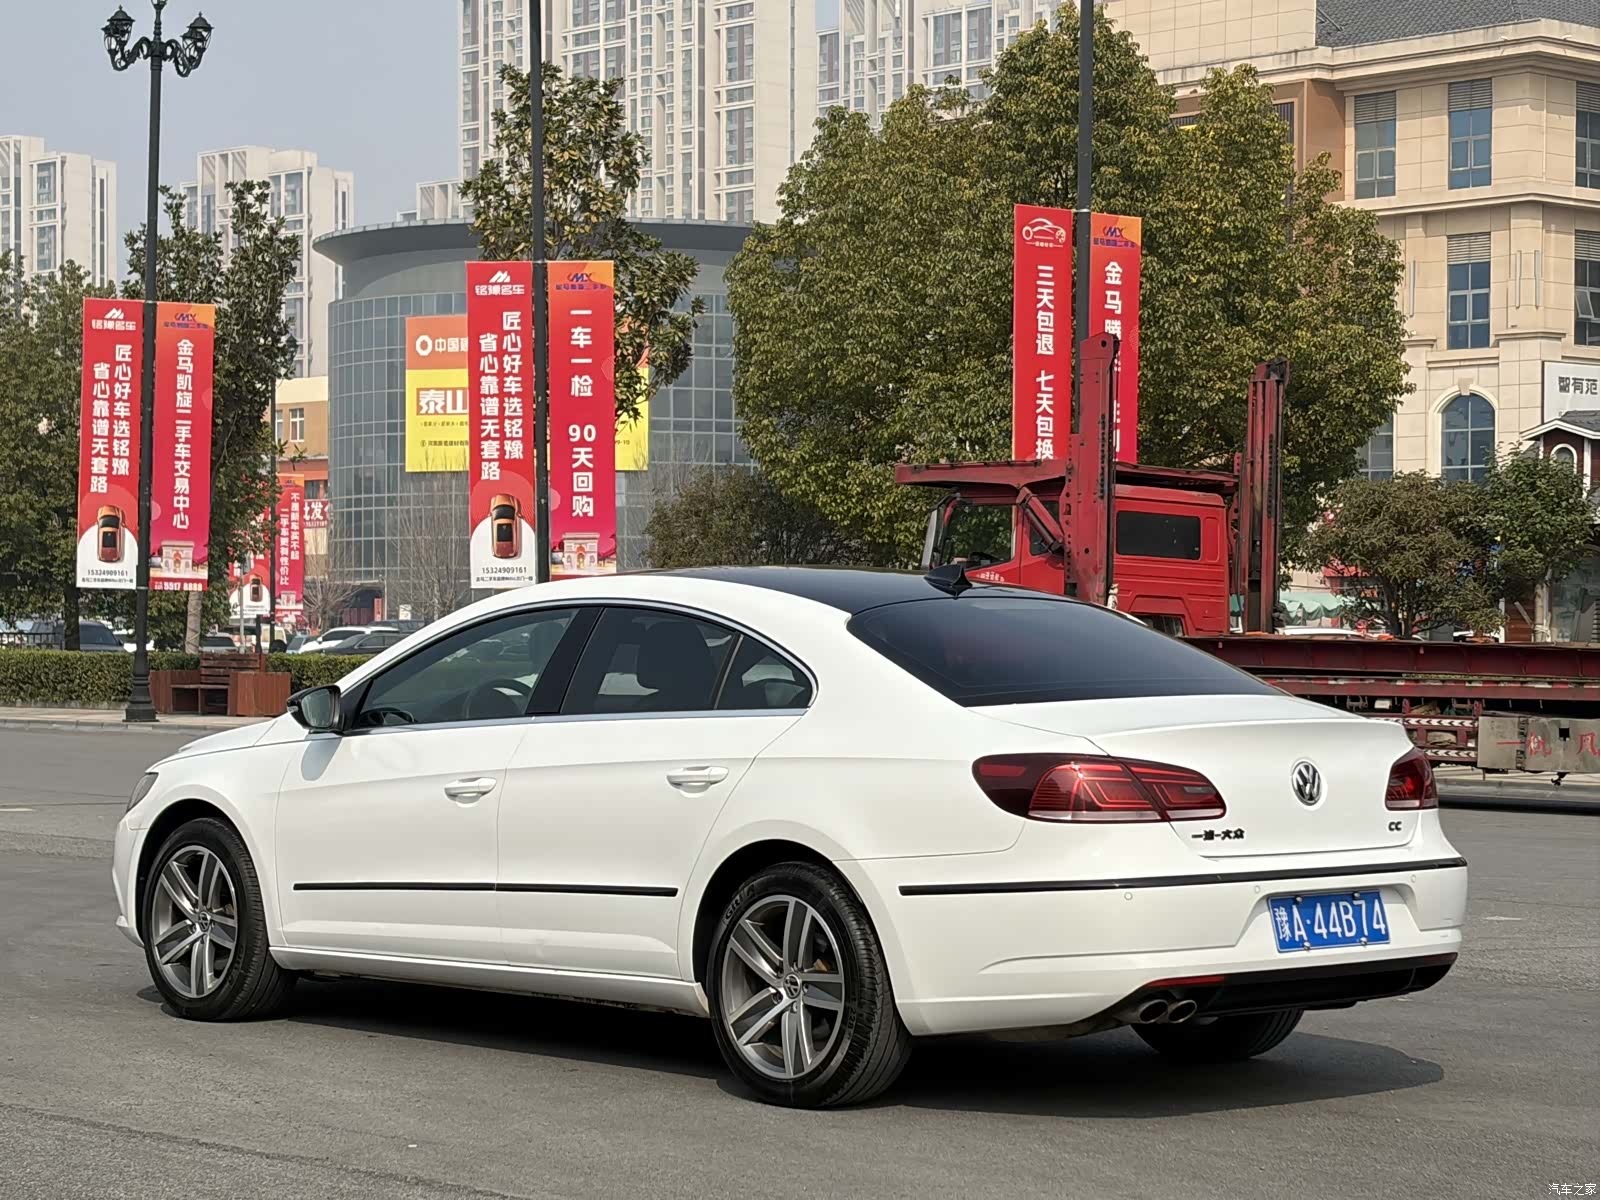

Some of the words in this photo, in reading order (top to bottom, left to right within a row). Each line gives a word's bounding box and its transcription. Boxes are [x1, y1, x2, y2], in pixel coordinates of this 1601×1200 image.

[570, 309, 593, 397] 一车一检
[1036, 266, 1054, 355] 三天包退
[90, 362, 111, 493] 省心靠谱无套路
[112, 344, 131, 476] 匠心好车选铭豫
[479, 334, 500, 480] 省心靠谱无套路
[503, 311, 523, 460] 匠心好车选铭豫
[1036, 370, 1054, 460] 七天包换
[172, 339, 194, 529] 金马凯旋二手车交易中心
[568, 424, 596, 517] 90天回购
[481, 566, 527, 574] 15324909161
[1388, 821, 1402, 831] CC
[1274, 898, 1387, 943] 豫A·44B74
